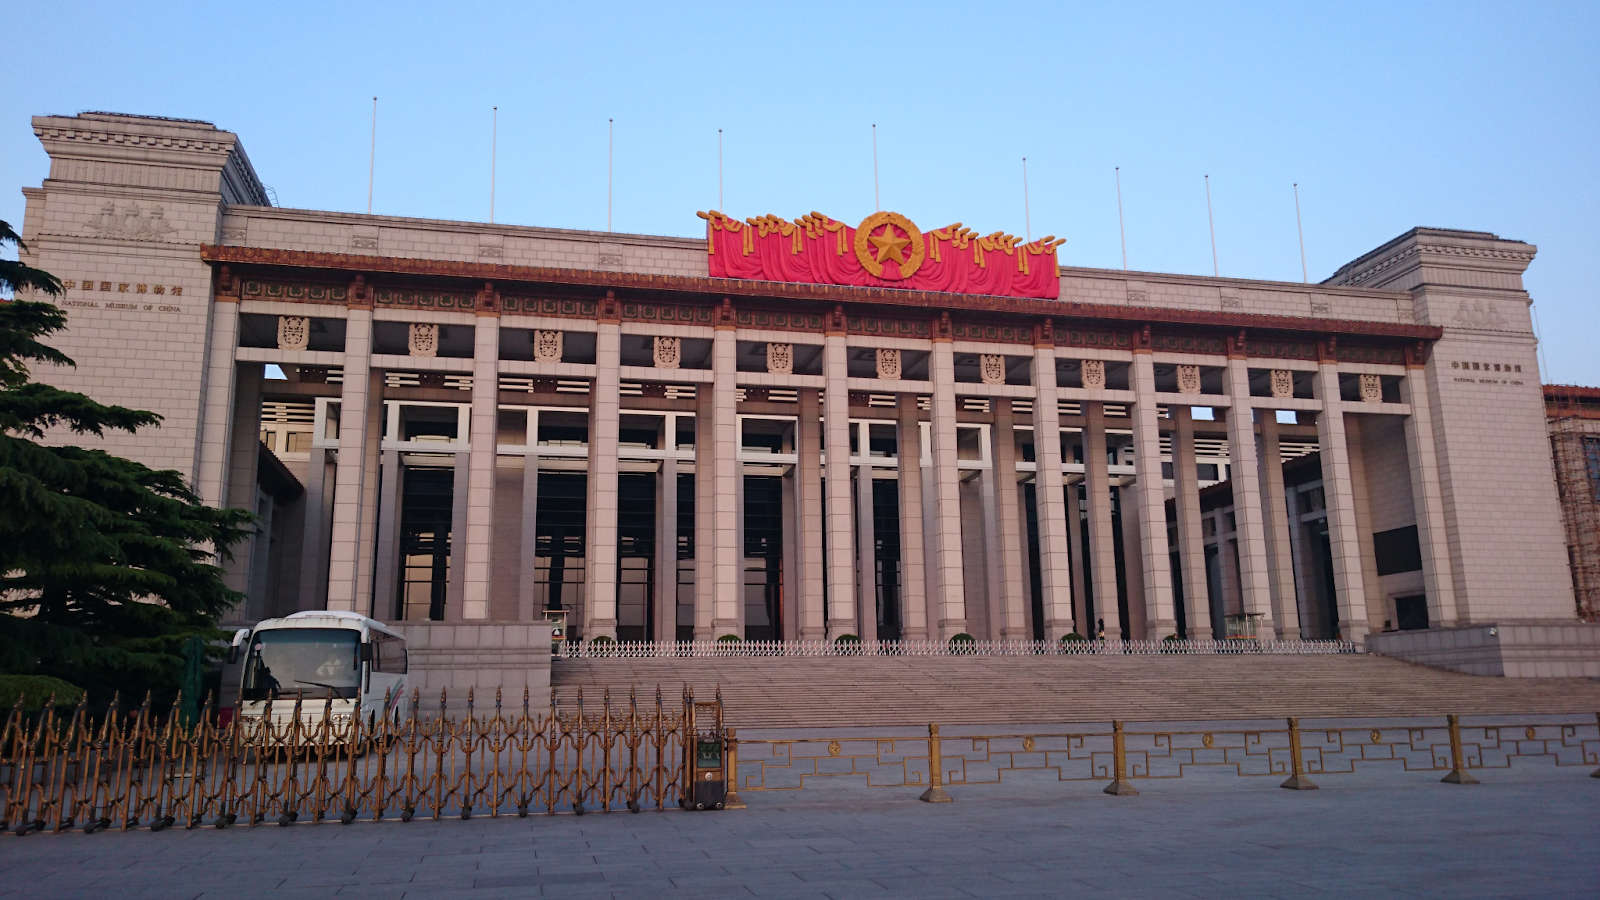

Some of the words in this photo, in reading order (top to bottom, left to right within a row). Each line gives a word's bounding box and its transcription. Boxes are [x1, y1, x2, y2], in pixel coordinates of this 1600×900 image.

[64, 280, 183, 296] 中国国家博物馆
